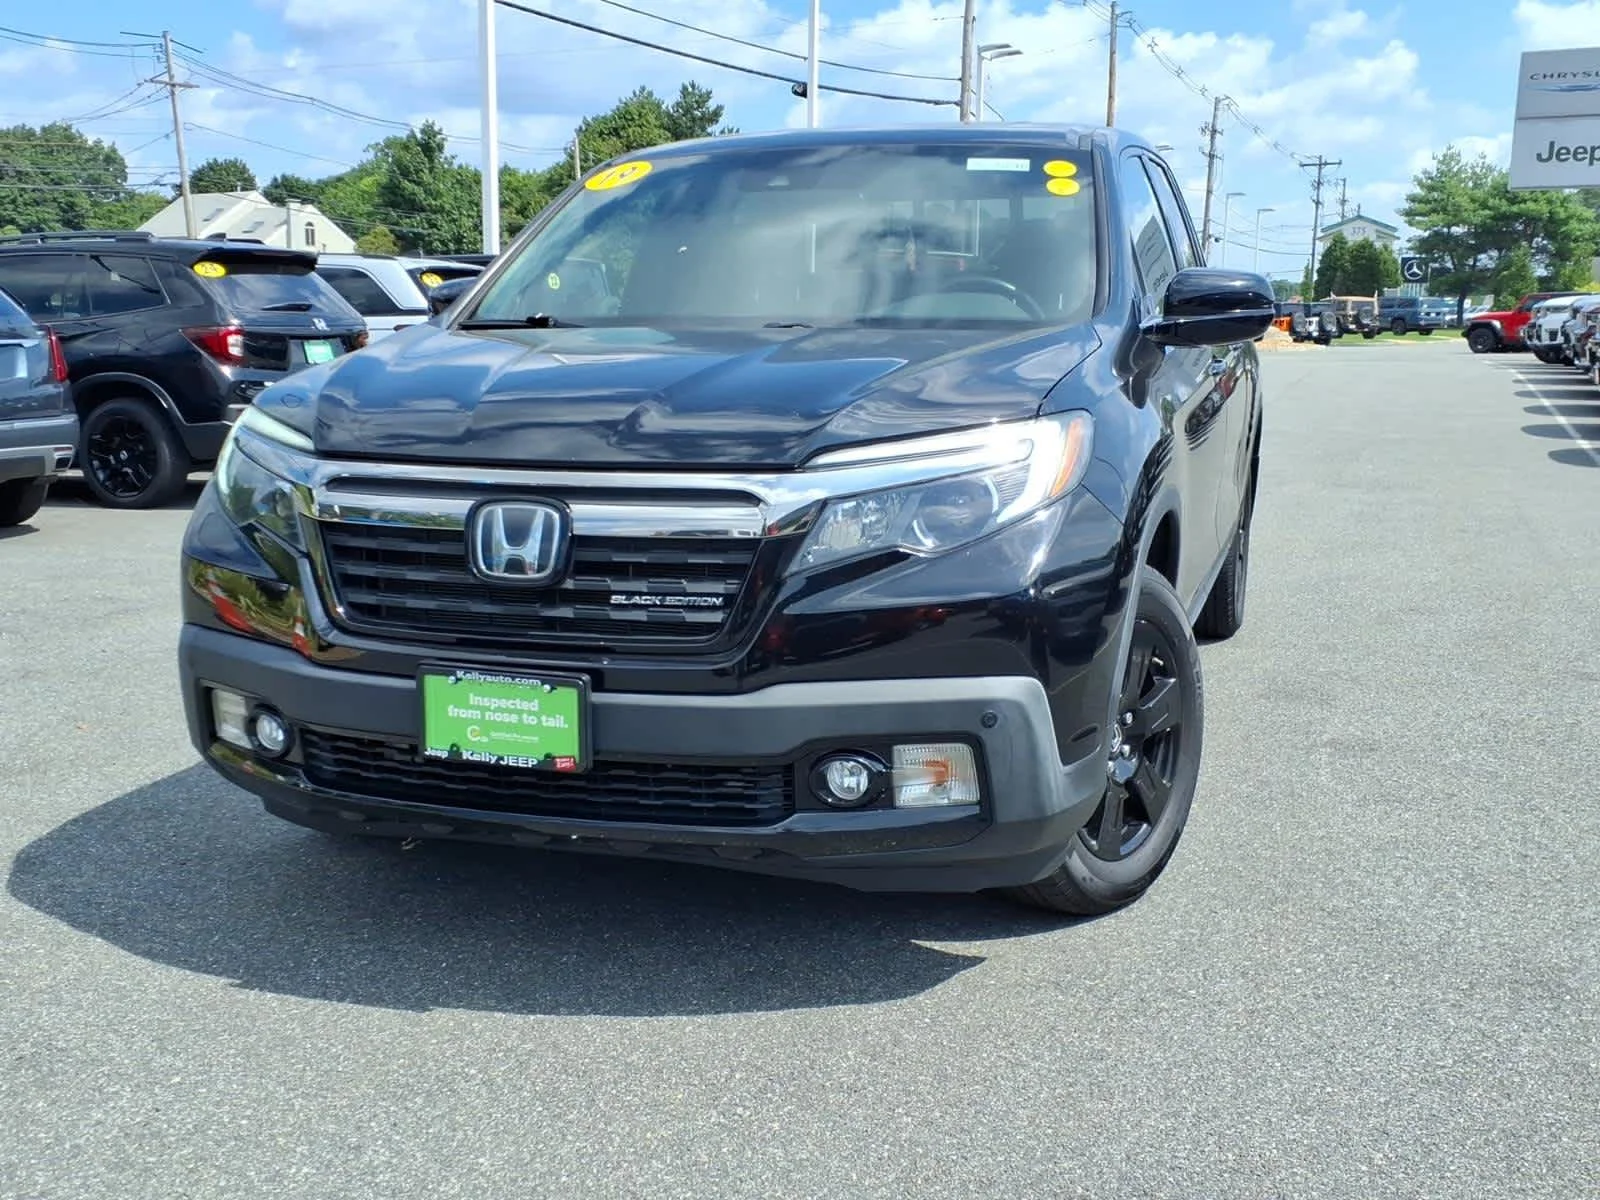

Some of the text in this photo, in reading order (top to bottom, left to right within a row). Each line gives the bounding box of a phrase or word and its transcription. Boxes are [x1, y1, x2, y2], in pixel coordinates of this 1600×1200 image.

[609, 595, 724, 606] BLACK EDITION
[456, 670, 542, 687] Kellyauto.com
[469, 692, 539, 712] Inspected
[448, 705, 568, 729] from nose to tail.
[462, 750, 499, 765] Kelly
[499, 755, 539, 768] JEEP
